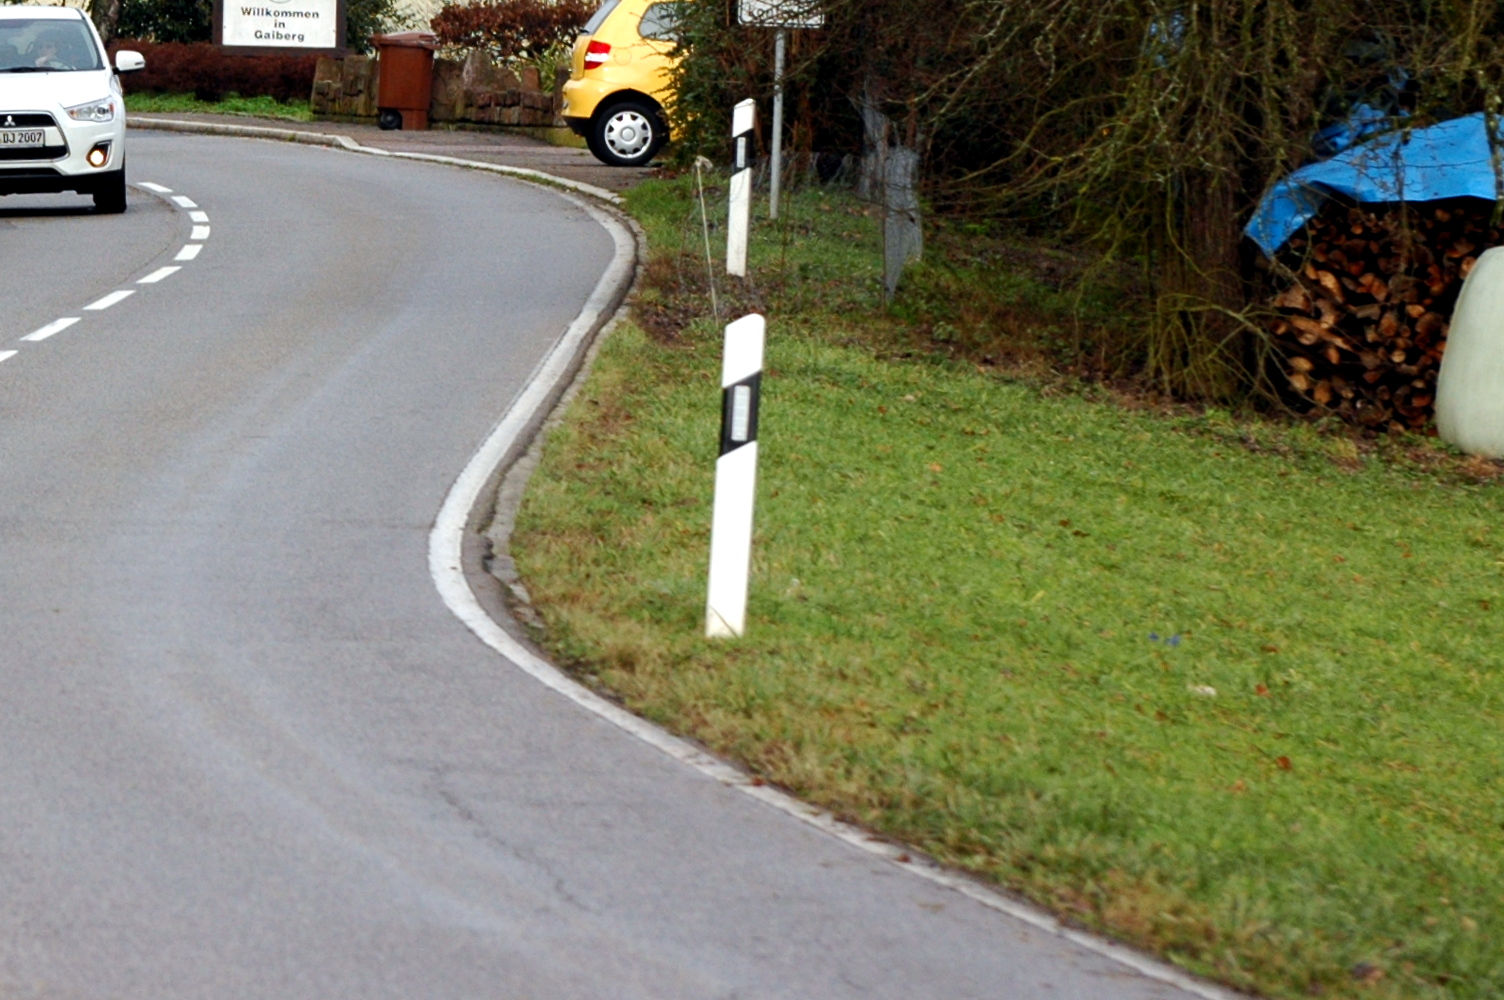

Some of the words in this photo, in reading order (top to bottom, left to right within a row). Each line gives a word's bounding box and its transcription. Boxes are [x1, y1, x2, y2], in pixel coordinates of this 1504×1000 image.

[241, 7, 320, 18] Willkommen
[274, 20, 285, 28] in
[254, 30, 305, 41] Gaiberg
[3, 132, 16, 143] DJ
[18, 132, 42, 143] 2007
